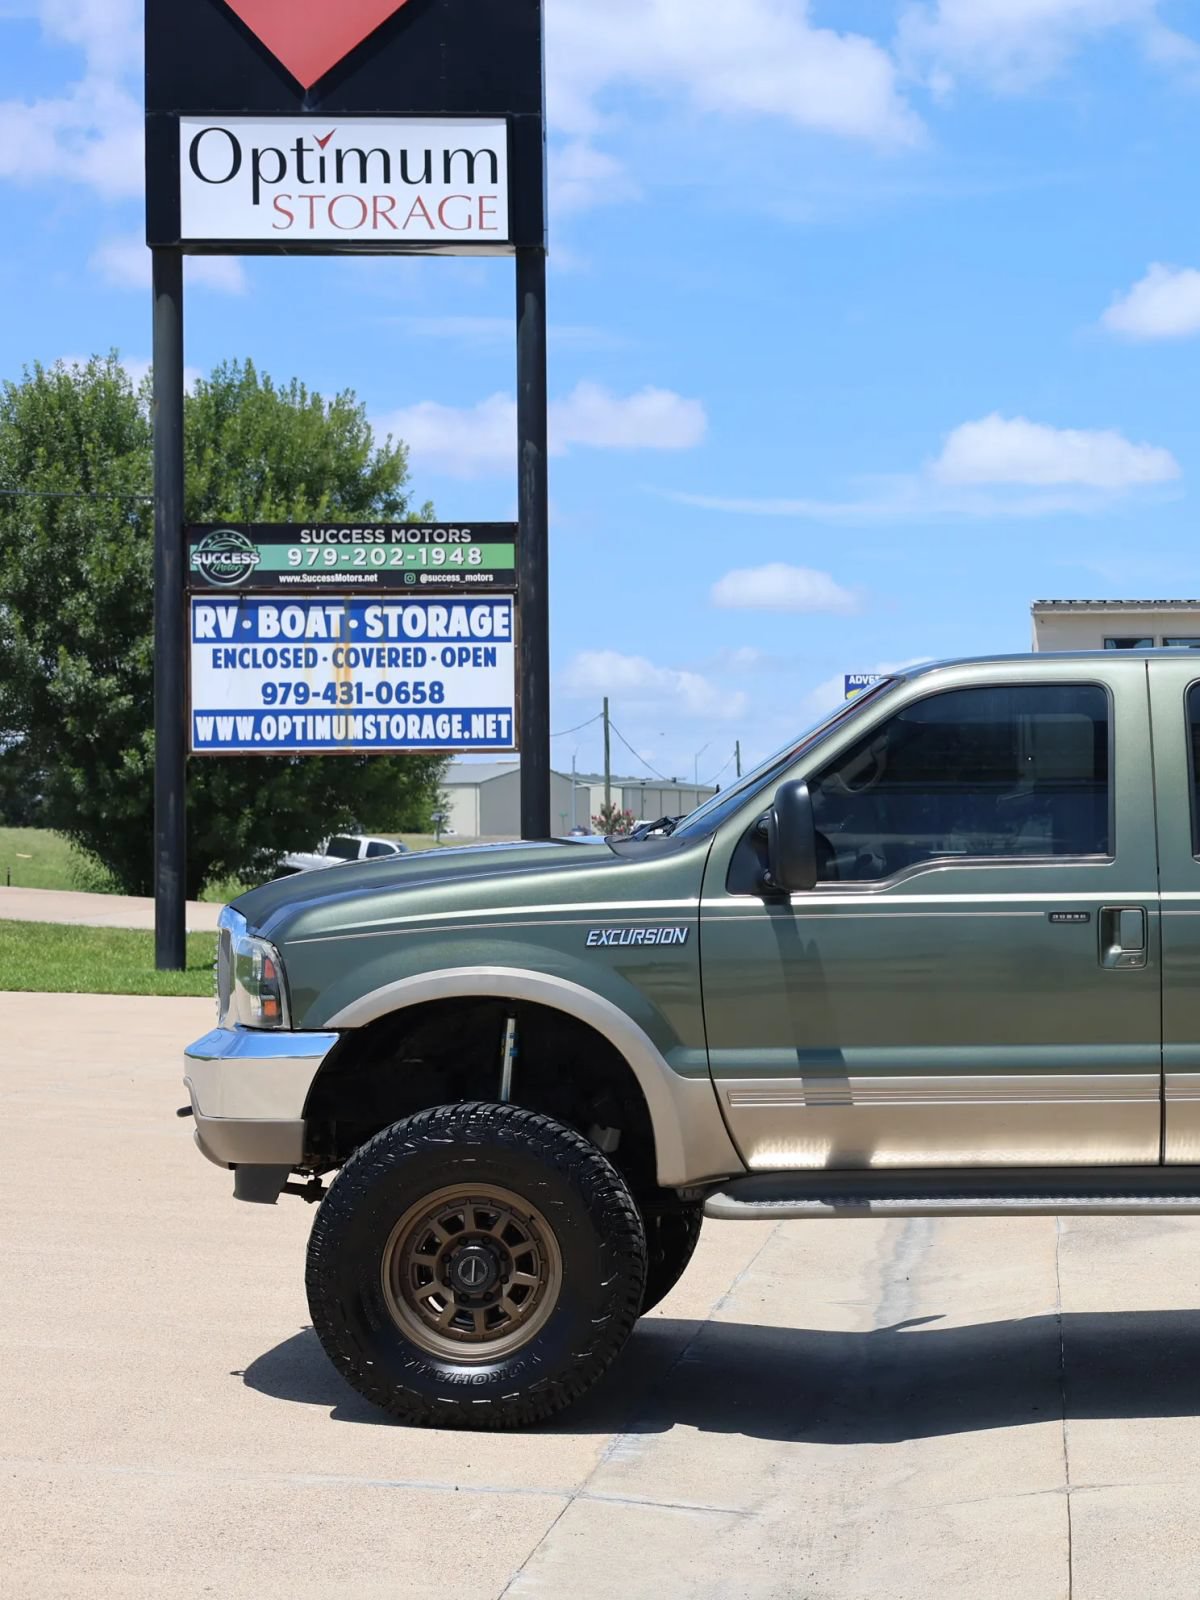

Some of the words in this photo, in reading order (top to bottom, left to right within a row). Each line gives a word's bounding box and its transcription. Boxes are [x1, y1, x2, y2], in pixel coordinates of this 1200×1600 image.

[188, 127, 498, 205] Optimum
[272, 194, 498, 231] STORAGE
[300, 529, 385, 543] SUCCESS
[391, 529, 472, 543] MOTORS
[191, 552, 260, 565] SUCCESS
[287, 547, 483, 566] 979-202-1948
[278, 573, 379, 583] www.SuccessMotors.net
[419, 573, 494, 584] @success_motors
[195, 605, 239, 638] RV
[257, 605, 345, 638] BOAT
[364, 605, 510, 638] STORAGE
[212, 648, 318, 669] ENCLOSED
[331, 647, 427, 668] COVERED
[440, 646, 497, 668] OPEN
[261, 681, 445, 705] 979-431-0658
[195, 713, 511, 741] WWW.OPTIMUMSTORAGE.NET
[586, 927, 690, 946] EXCURSION
